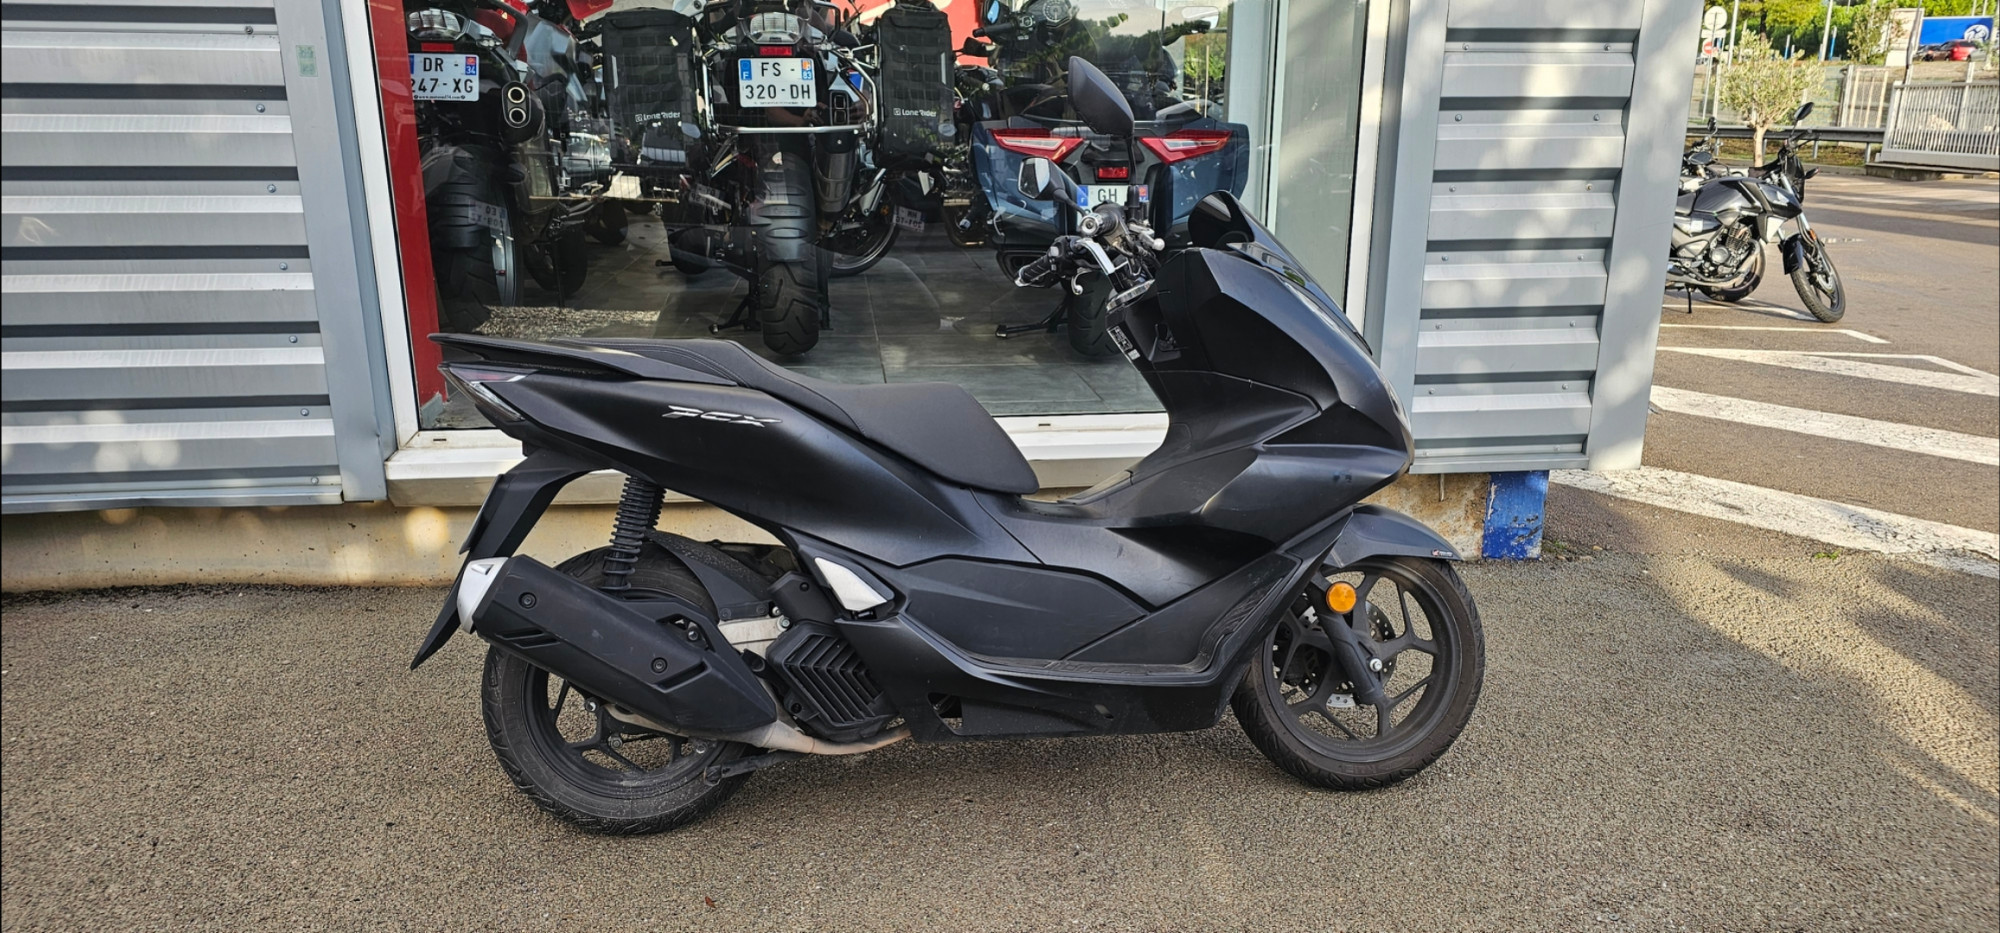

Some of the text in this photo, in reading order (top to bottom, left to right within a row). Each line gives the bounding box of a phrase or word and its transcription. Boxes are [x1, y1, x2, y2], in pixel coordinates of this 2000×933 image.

[423, 57, 444, 72] DR
[466, 66, 476, 75] 34
[761, 62, 781, 77] FS
[742, 72, 750, 80] F
[745, 84, 811, 100] 320-DH
[1097, 188, 1118, 203] GH
[661, 404, 783, 428] PCX
